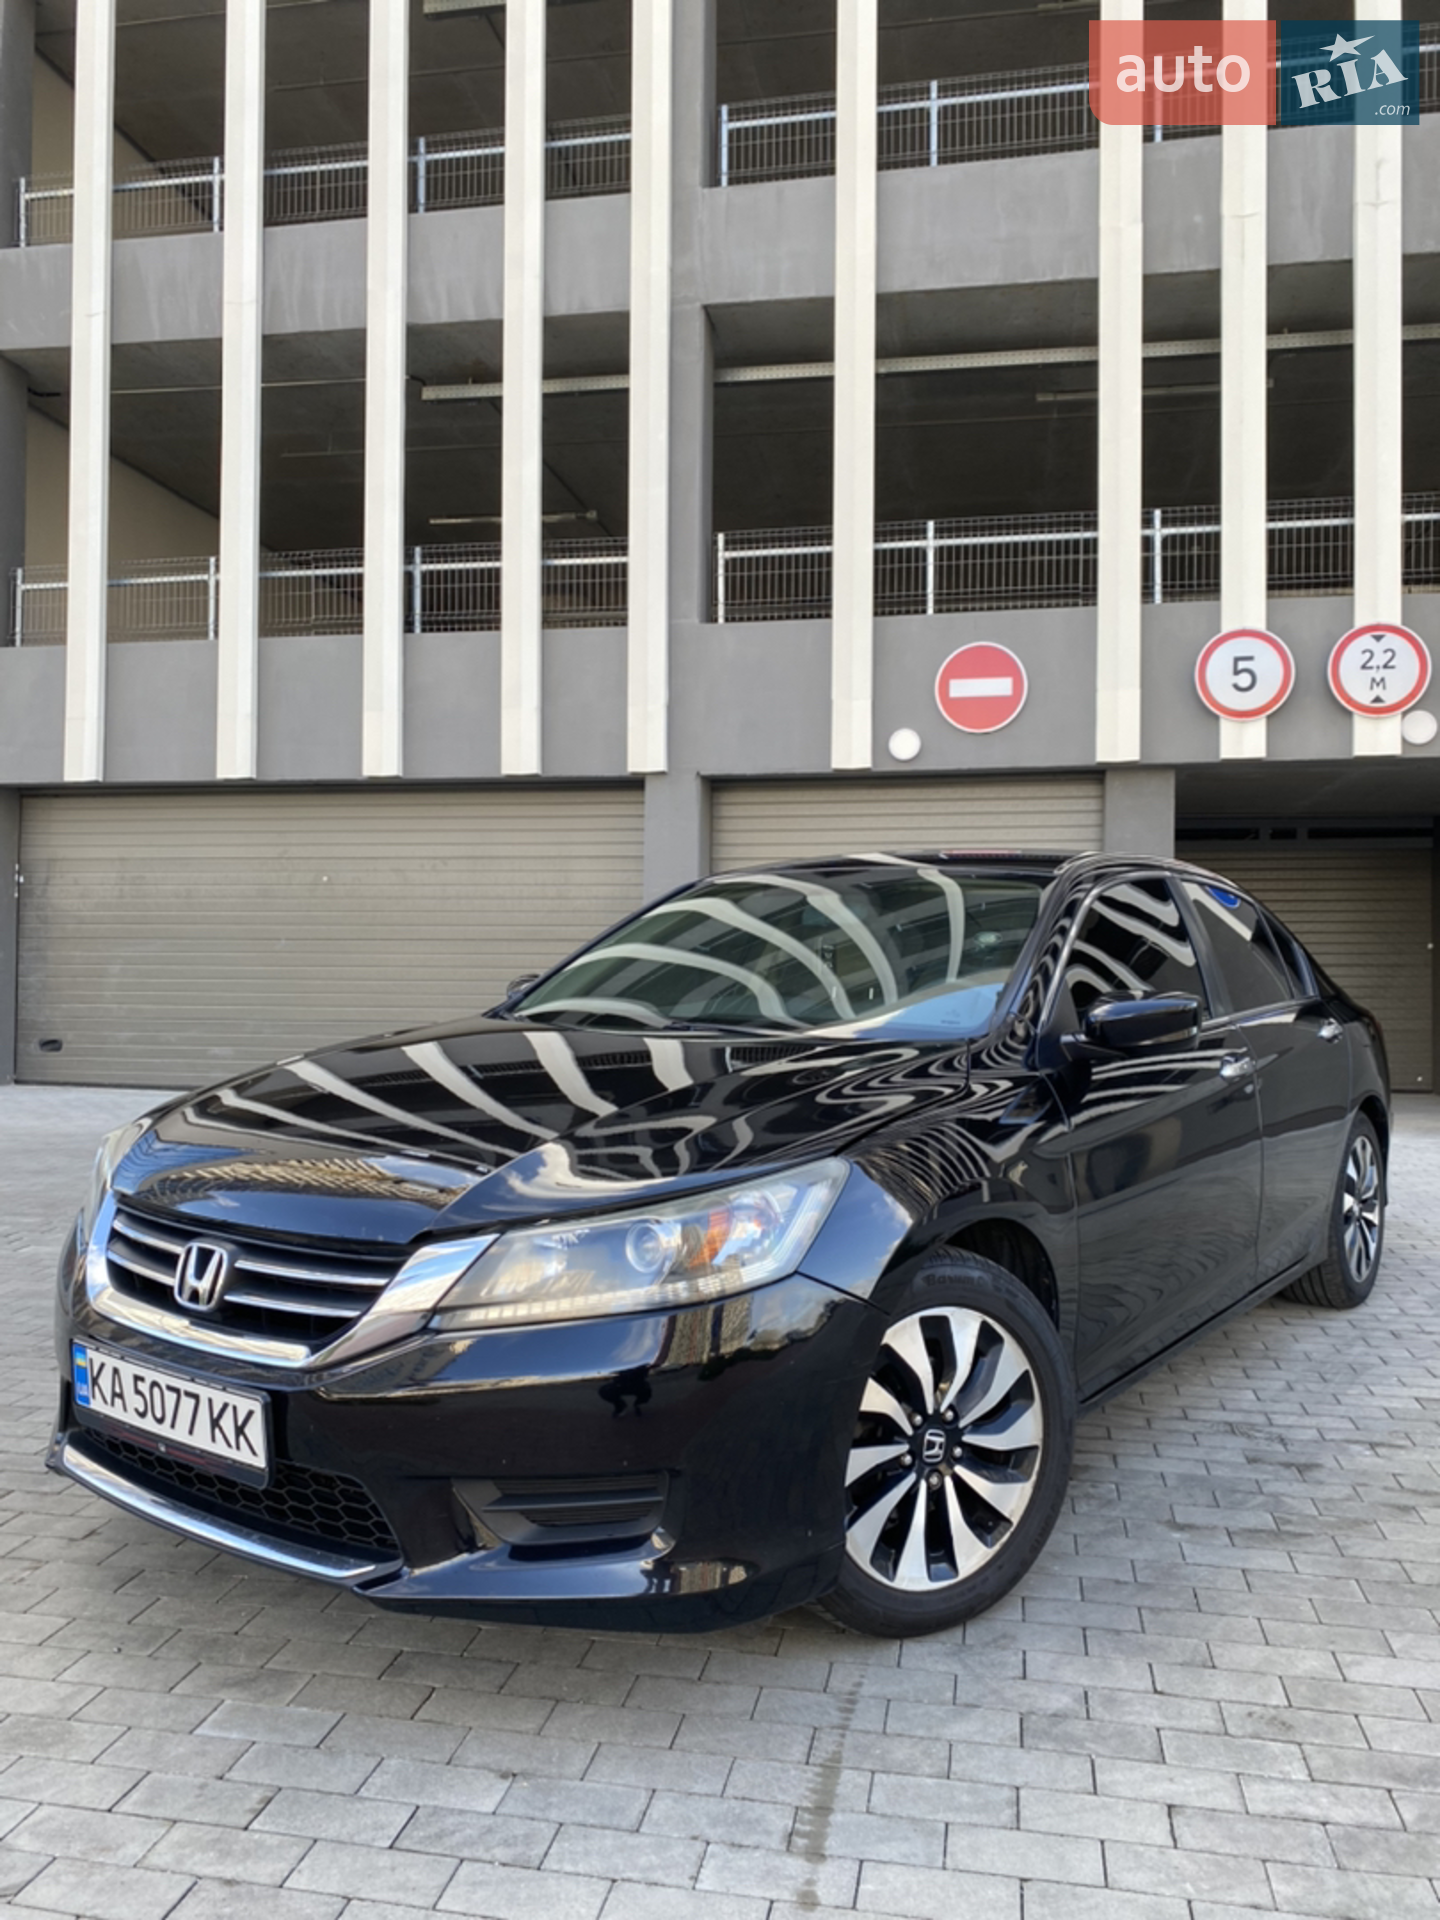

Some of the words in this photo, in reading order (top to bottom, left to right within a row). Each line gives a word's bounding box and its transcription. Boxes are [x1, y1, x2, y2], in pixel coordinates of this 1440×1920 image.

[1231, 655, 1257, 692] 5
[1360, 648, 1397, 672] 2,2
[89, 1357, 128, 1412] KA
[132, 1373, 200, 1436] 5077
[208, 1396, 258, 1457] KK
